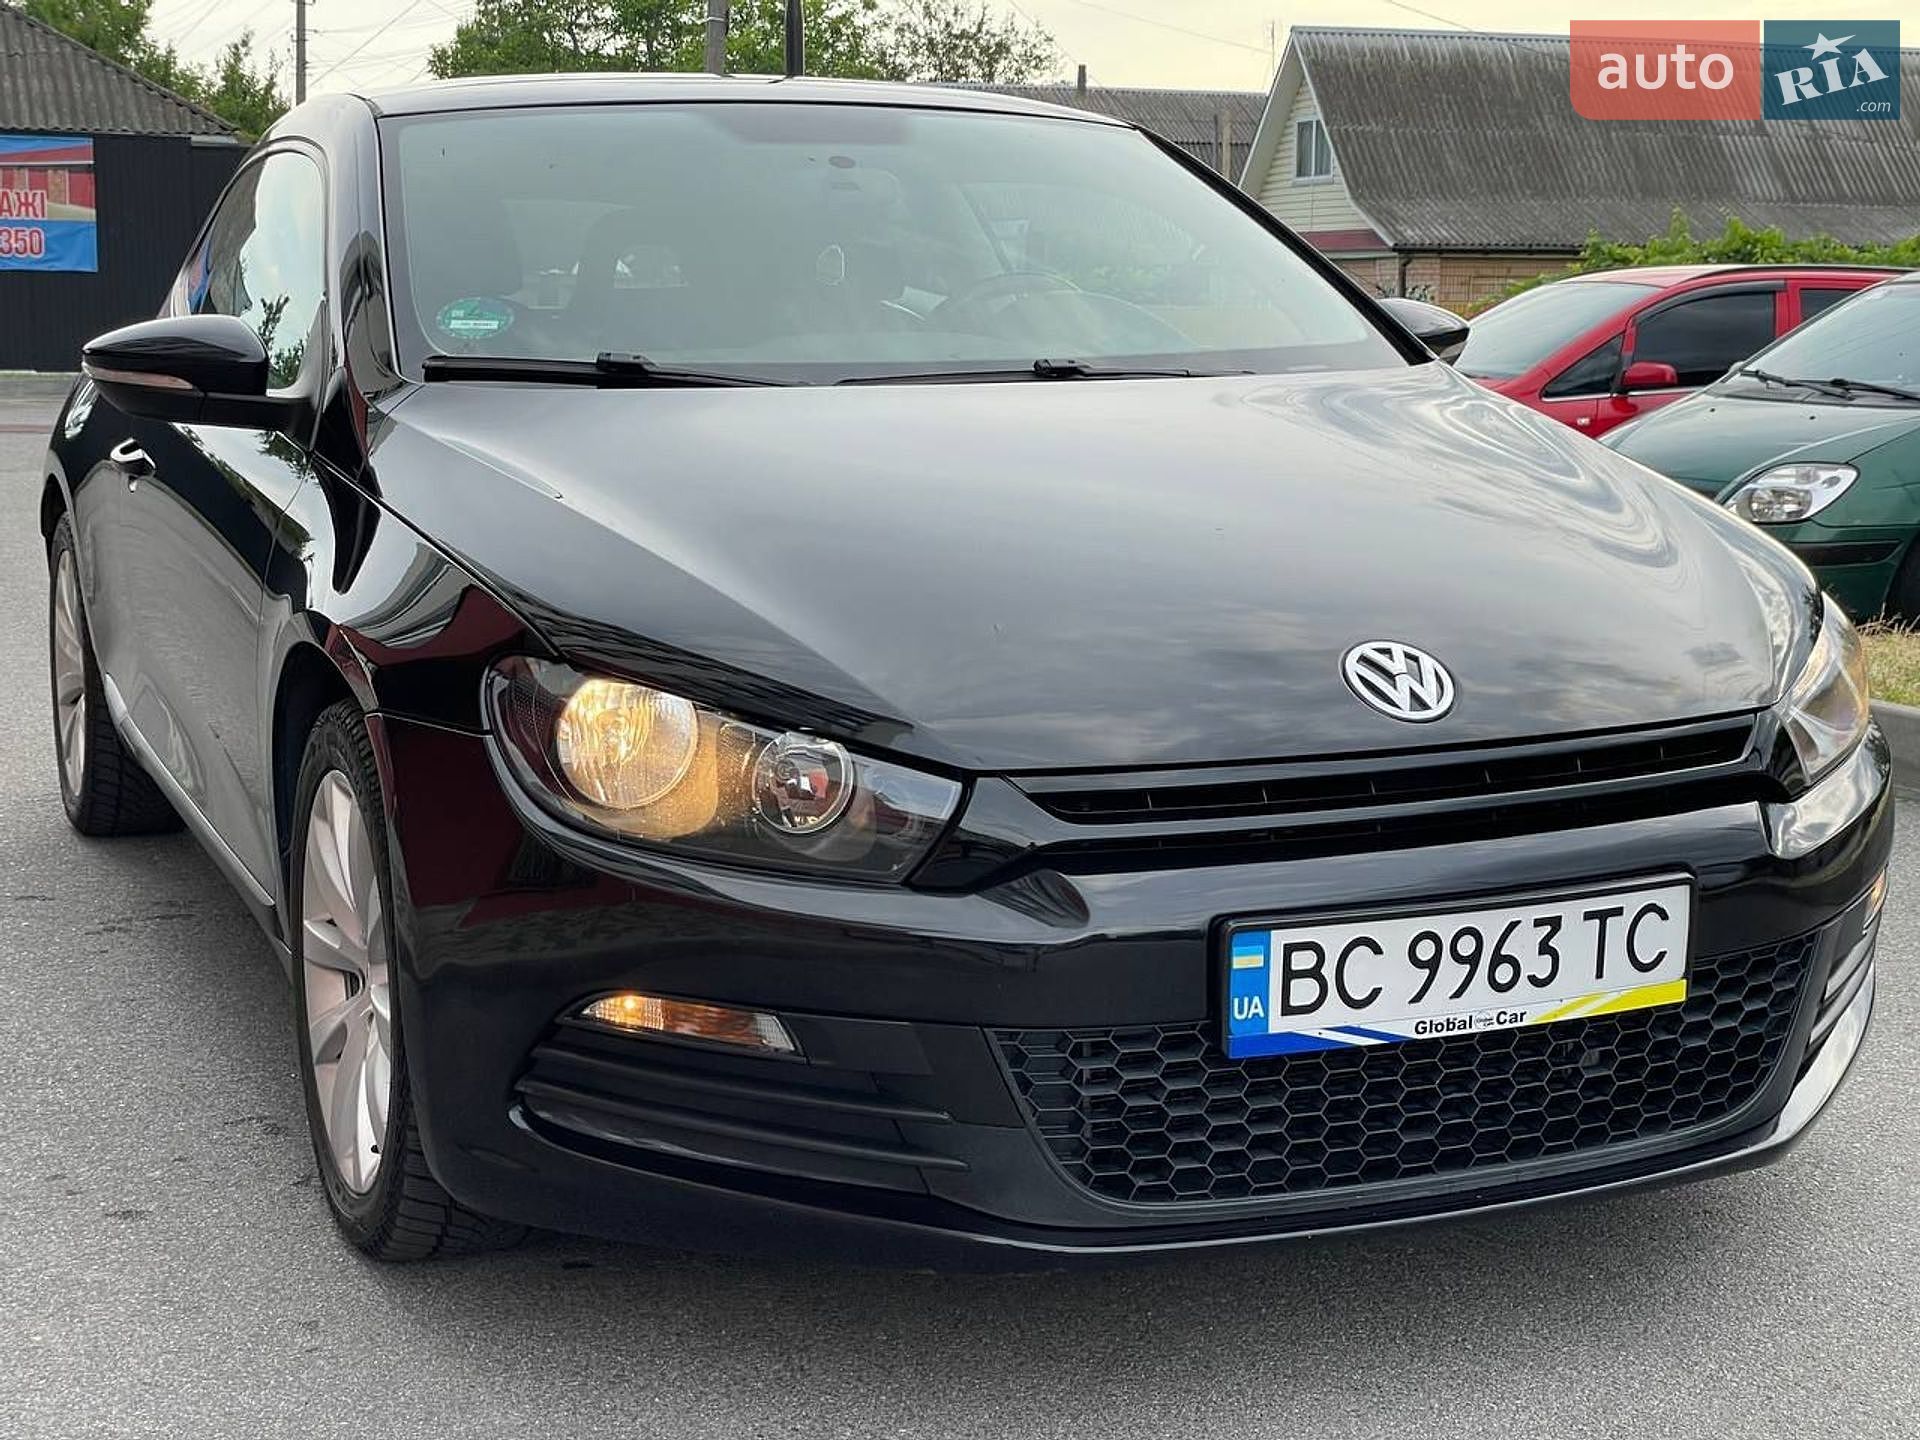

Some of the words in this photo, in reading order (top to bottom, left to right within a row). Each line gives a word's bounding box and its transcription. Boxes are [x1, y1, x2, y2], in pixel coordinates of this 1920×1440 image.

[0, 229, 43, 255] 350
[1280, 935, 1384, 1017] BC
[1407, 914, 1563, 1005] 9963
[1583, 903, 1671, 980] TC
[1233, 995, 1265, 1020] UA
[1414, 1015, 1473, 1035] Global
[1496, 1011, 1527, 1025] Car
